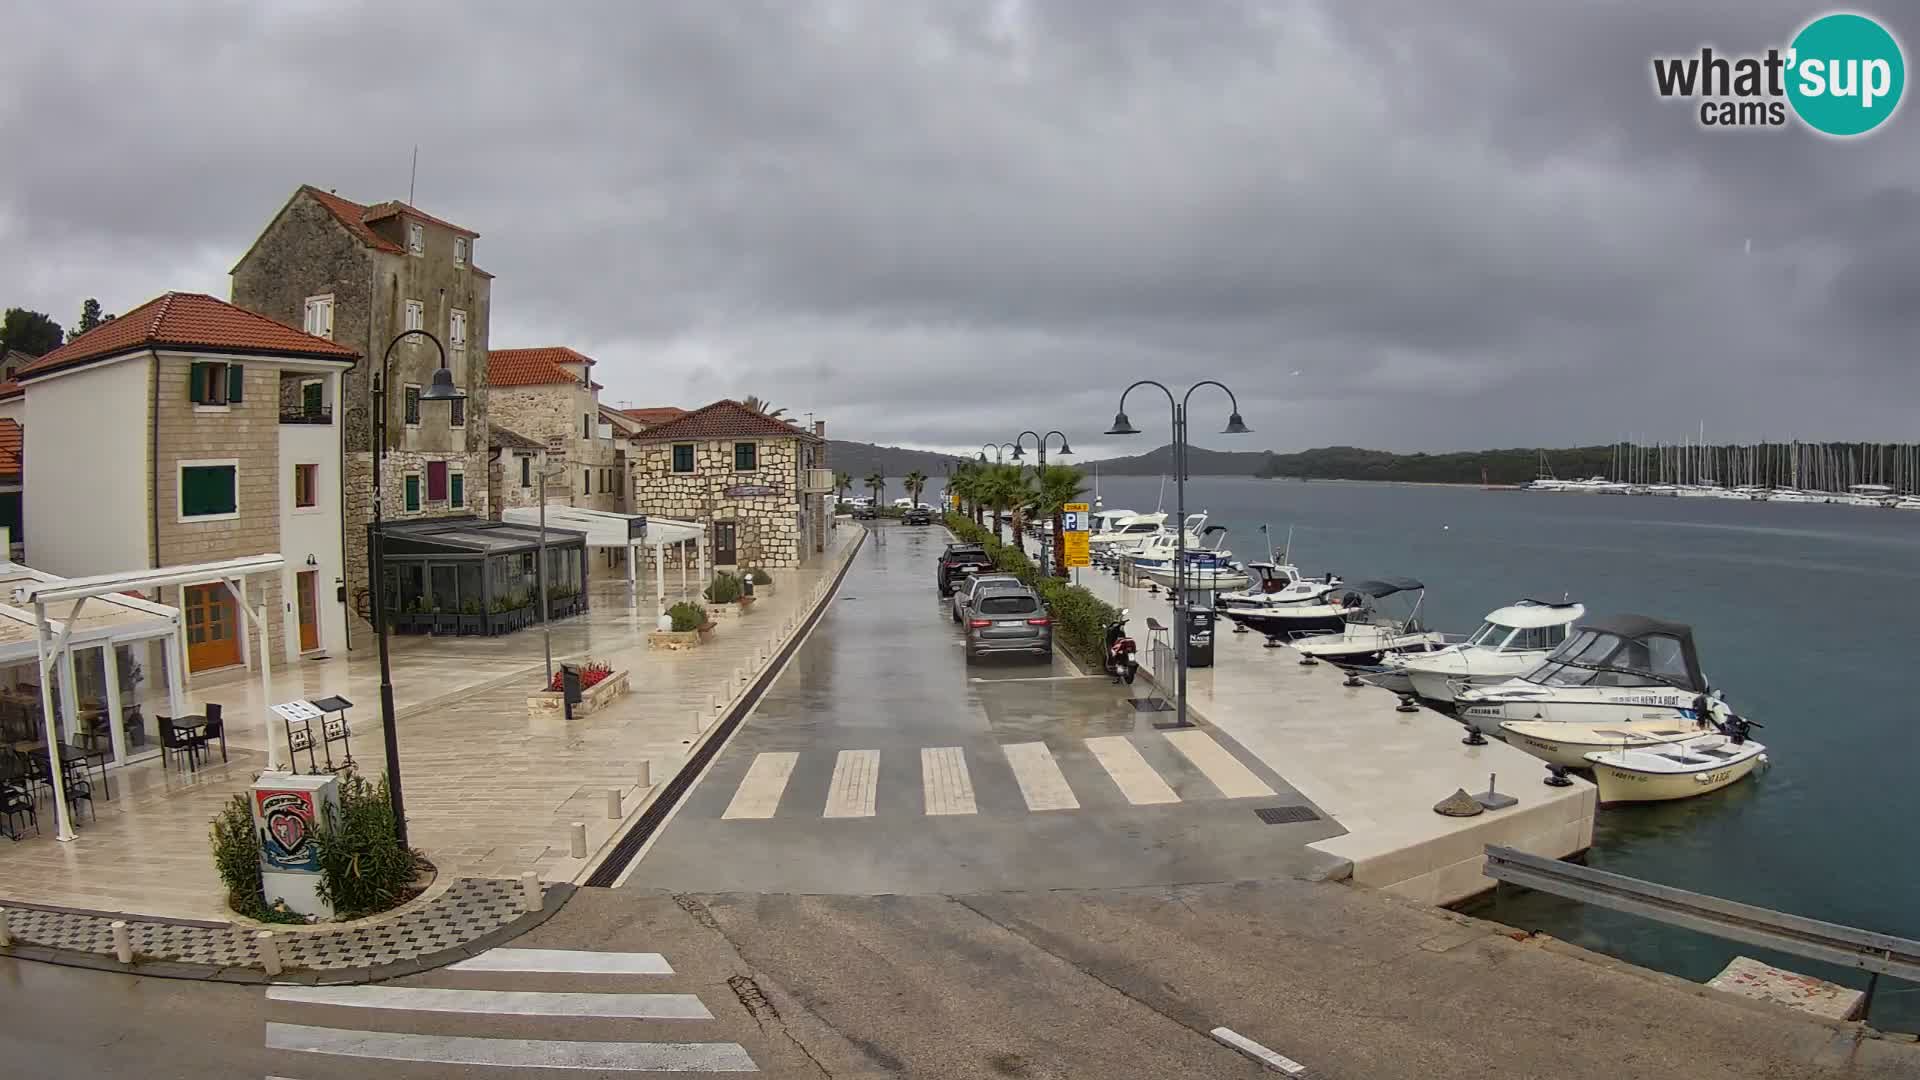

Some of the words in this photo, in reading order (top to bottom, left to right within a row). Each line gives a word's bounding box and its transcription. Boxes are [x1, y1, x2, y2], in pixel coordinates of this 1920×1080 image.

[1065, 513, 1076, 530] P
[1640, 695, 1657, 705] RENT
[1658, 696, 1663, 705] A
[1664, 695, 1680, 706] BOAT
